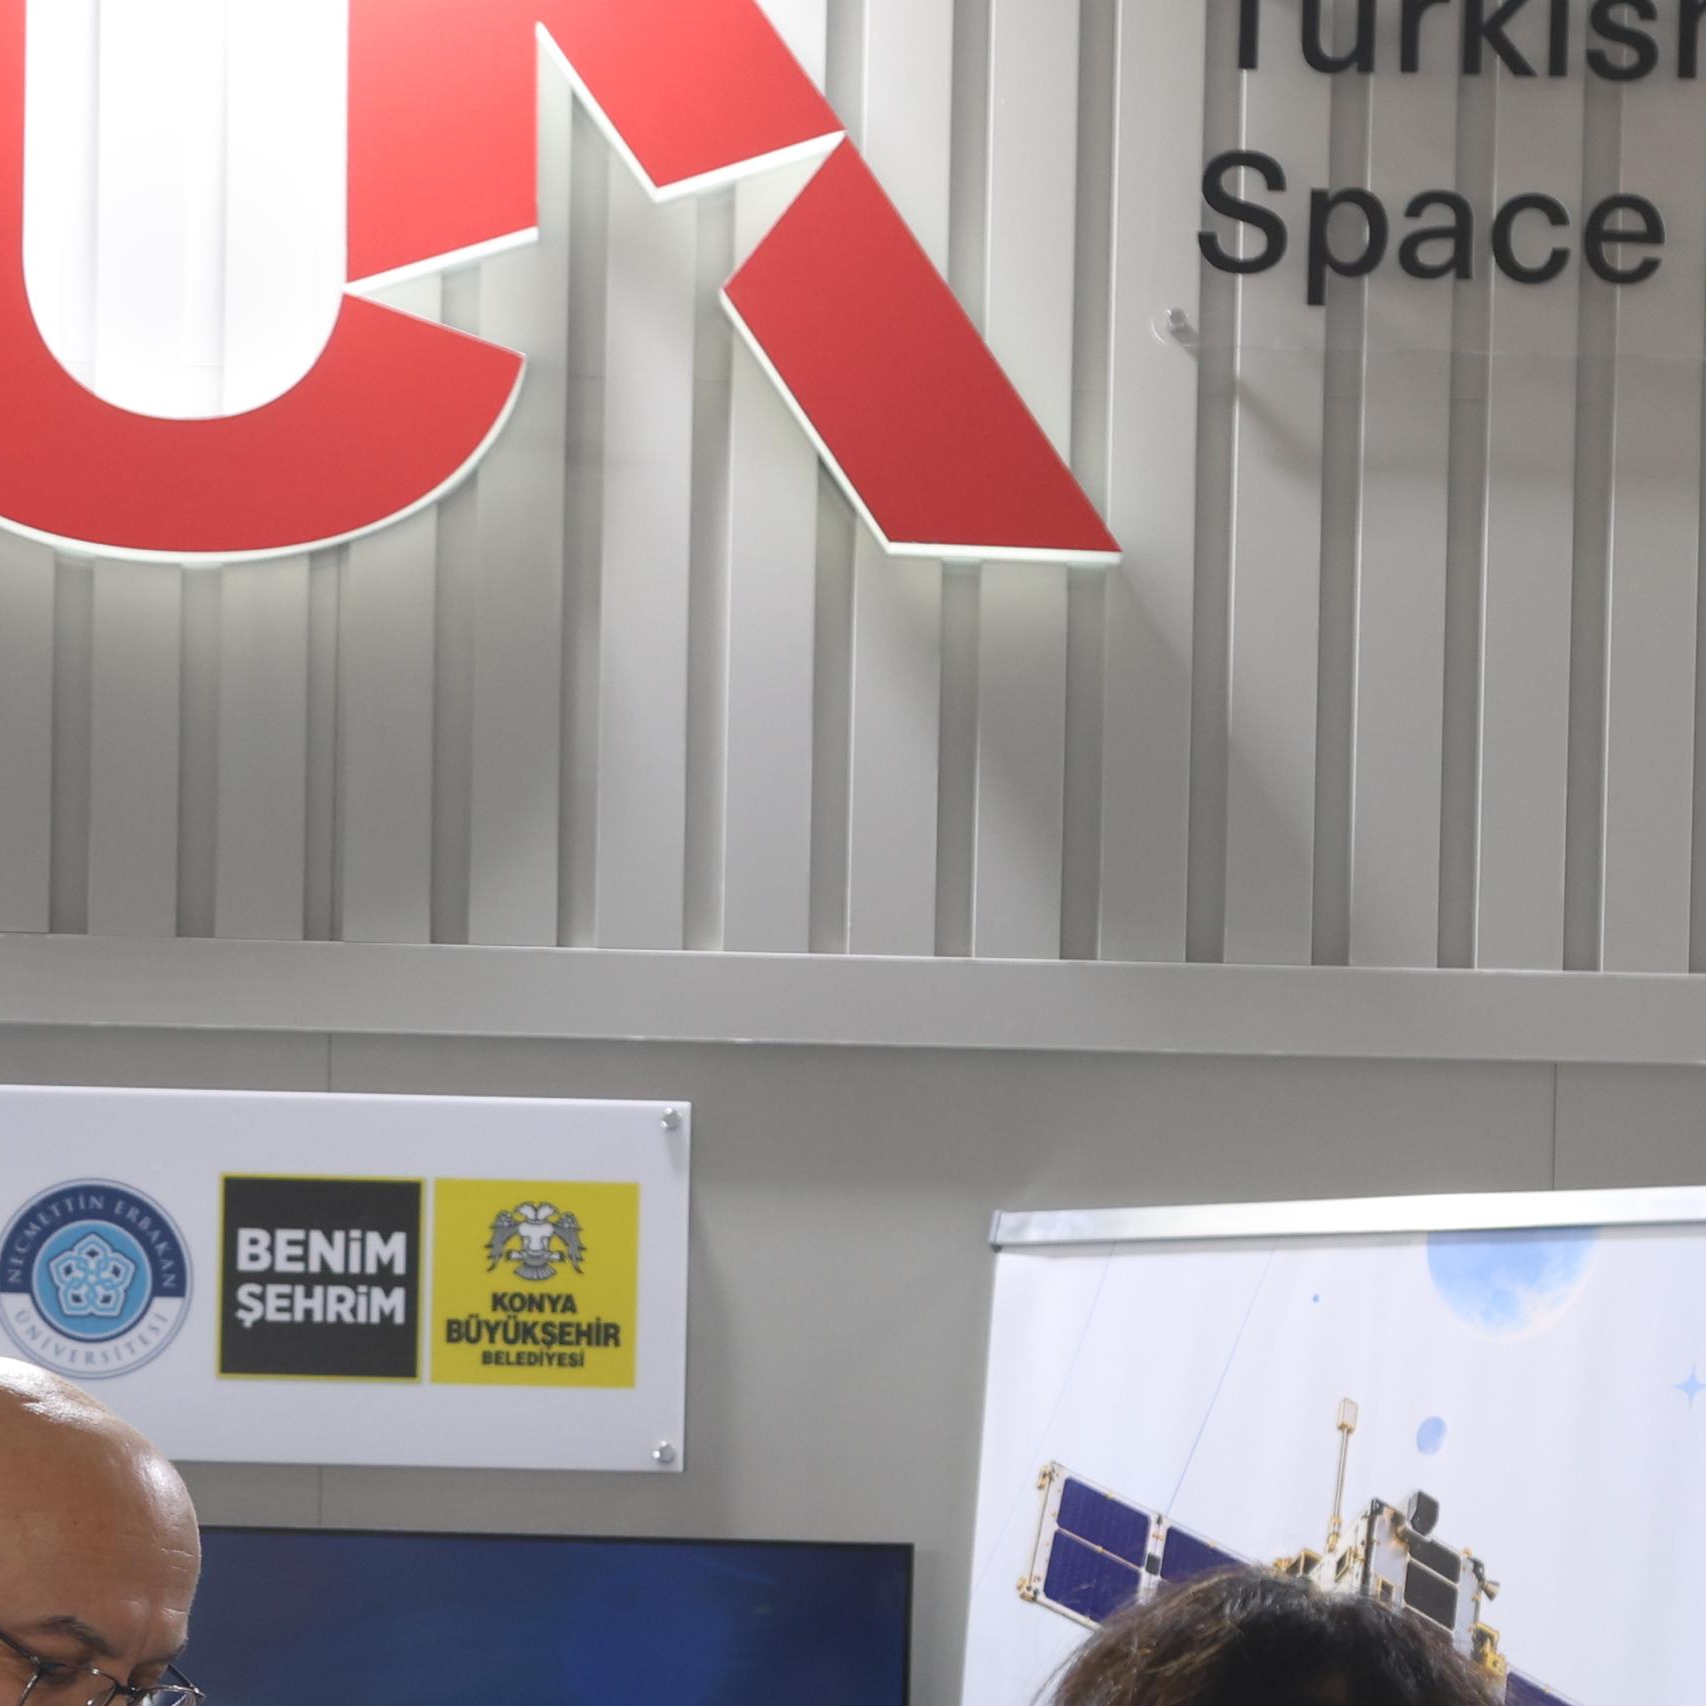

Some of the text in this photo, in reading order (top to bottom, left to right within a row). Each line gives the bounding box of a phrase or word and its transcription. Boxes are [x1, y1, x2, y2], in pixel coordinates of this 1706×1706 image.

[1197, 150, 1665, 307] Space
[114, 1199, 177, 1289] ERBAKAN
[446, 1314, 621, 1348] BÜYÜKŞEHİR
[491, 1292, 577, 1313] KONYA
